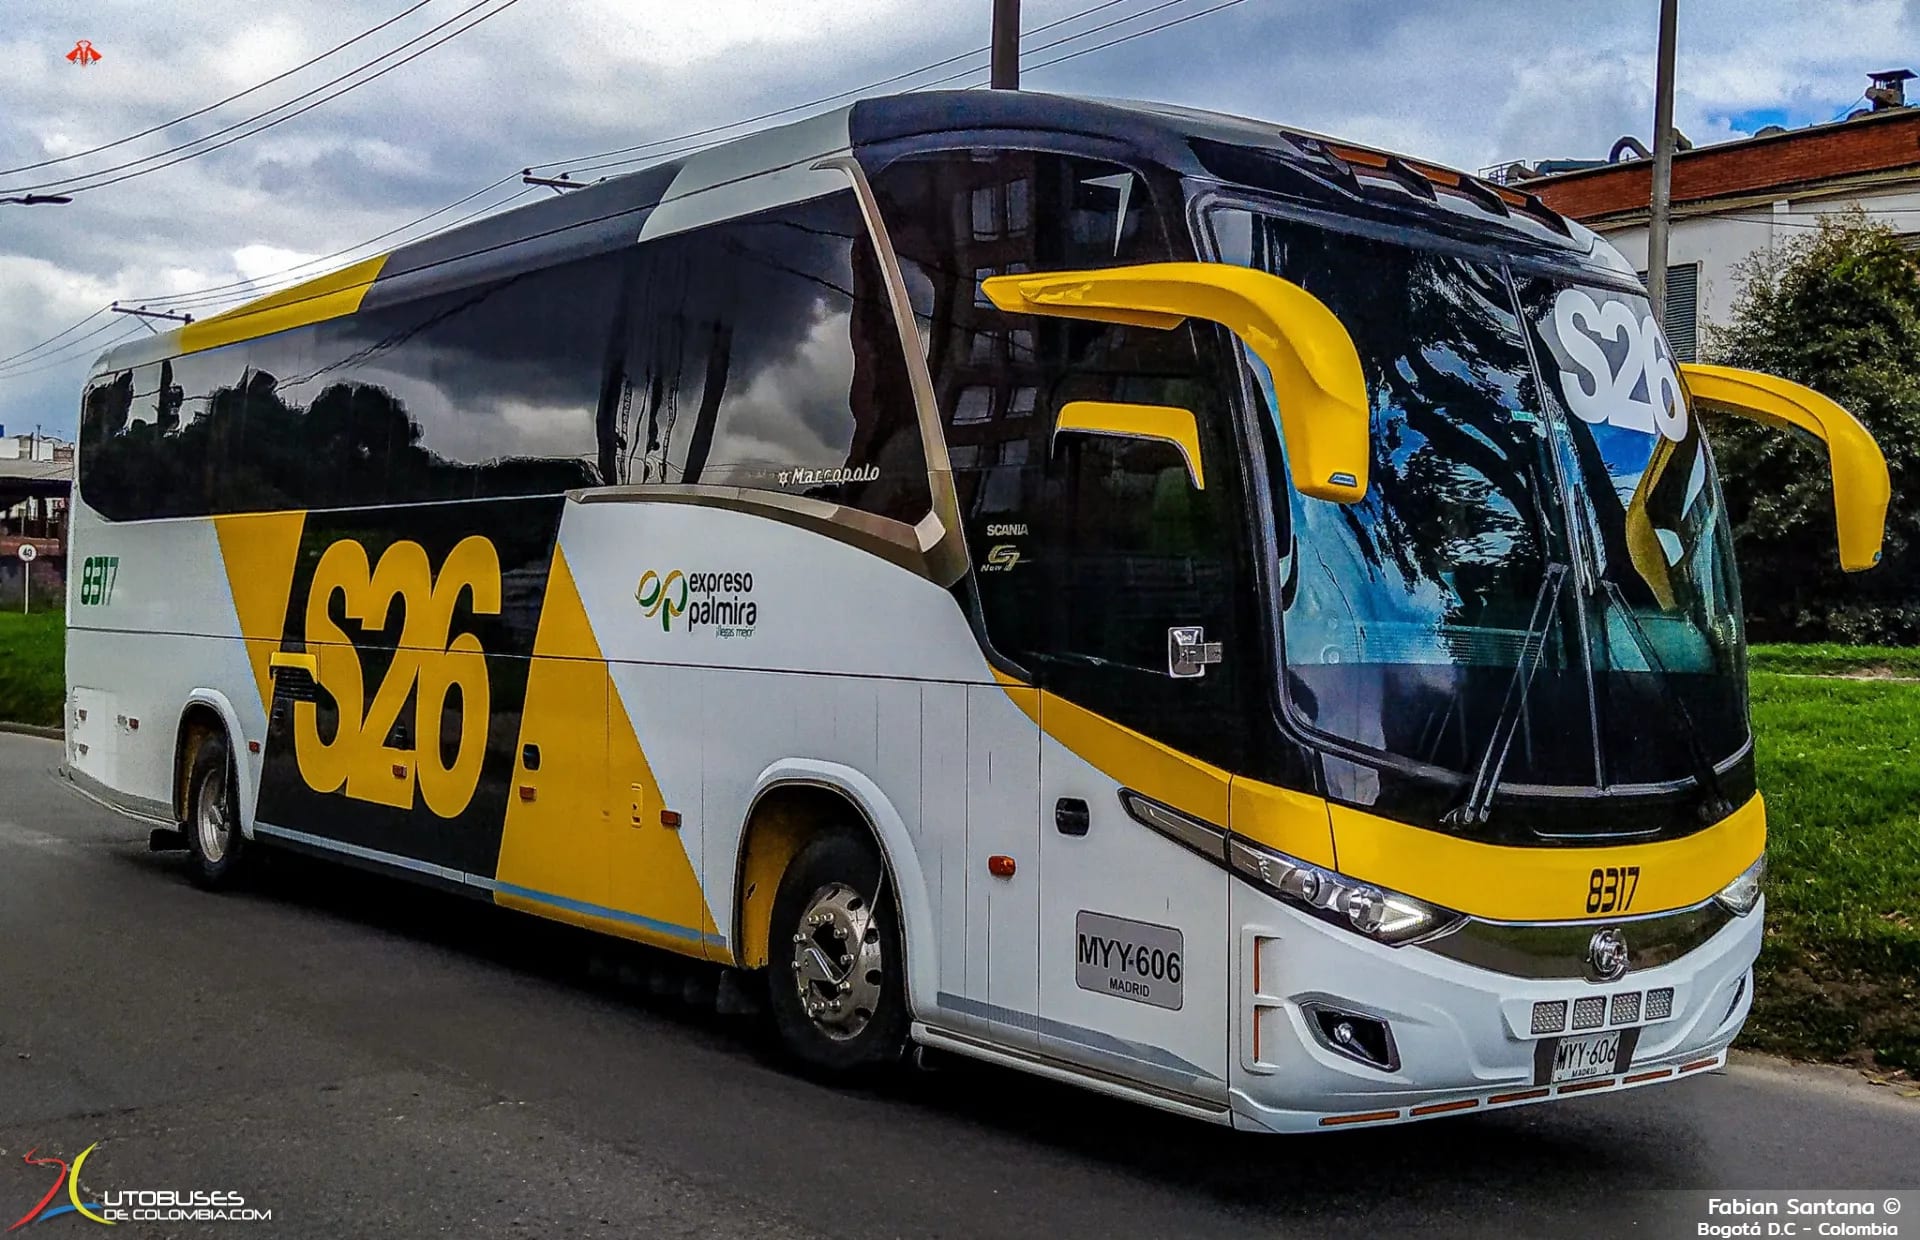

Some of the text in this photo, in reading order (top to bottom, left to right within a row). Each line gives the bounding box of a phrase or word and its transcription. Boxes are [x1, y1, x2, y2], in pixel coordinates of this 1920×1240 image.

[1554, 288, 1688, 442] S26
[791, 463, 880, 485] Marcopolo
[986, 523, 1029, 536] SCANIA
[81, 556, 120, 606] 8317
[688, 571, 754, 600] expreso
[687, 595, 757, 633] palmira
[293, 535, 502, 818] S26
[1585, 866, 1641, 914] 8317
[1109, 977, 1151, 998] MADRID
